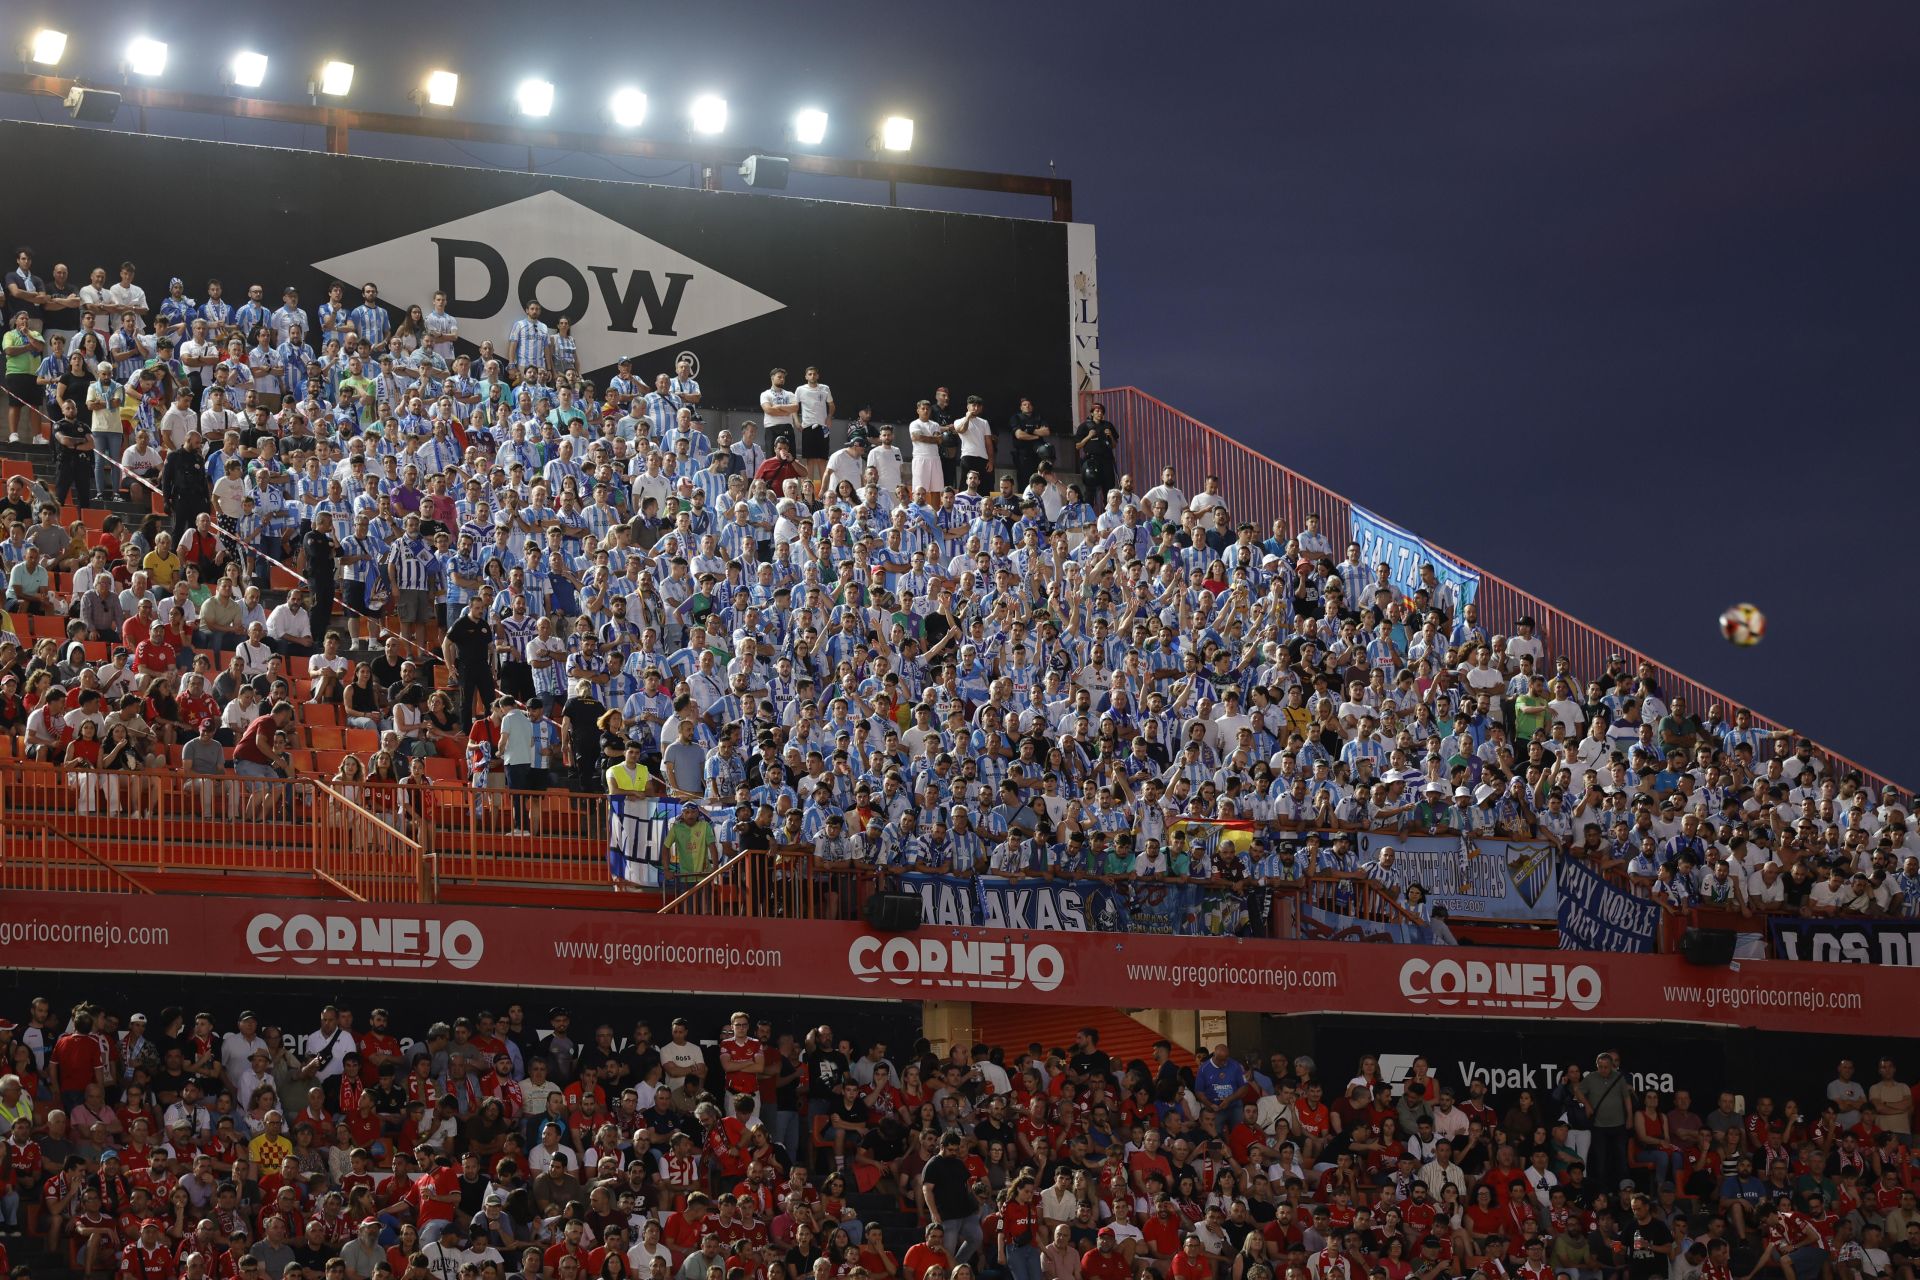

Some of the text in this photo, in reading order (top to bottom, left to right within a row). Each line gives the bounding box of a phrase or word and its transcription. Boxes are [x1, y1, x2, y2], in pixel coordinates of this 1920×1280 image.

[430, 236, 694, 336] DOW
[1465, 900, 1487, 913] 2007
[1597, 886, 1657, 938] NOBLE
[246, 912, 484, 969] CORNEJO
[554, 940, 782, 969] www.gregoriocornejo.com
[849, 936, 1065, 992] CORNEJO
[1126, 963, 1337, 990] www.gregoriocornejo.com
[1399, 958, 1602, 1011] CORNEJO
[1663, 985, 1862, 1011] www.gregoriocornejo.com
[1458, 1061, 1537, 1095] Vopak
